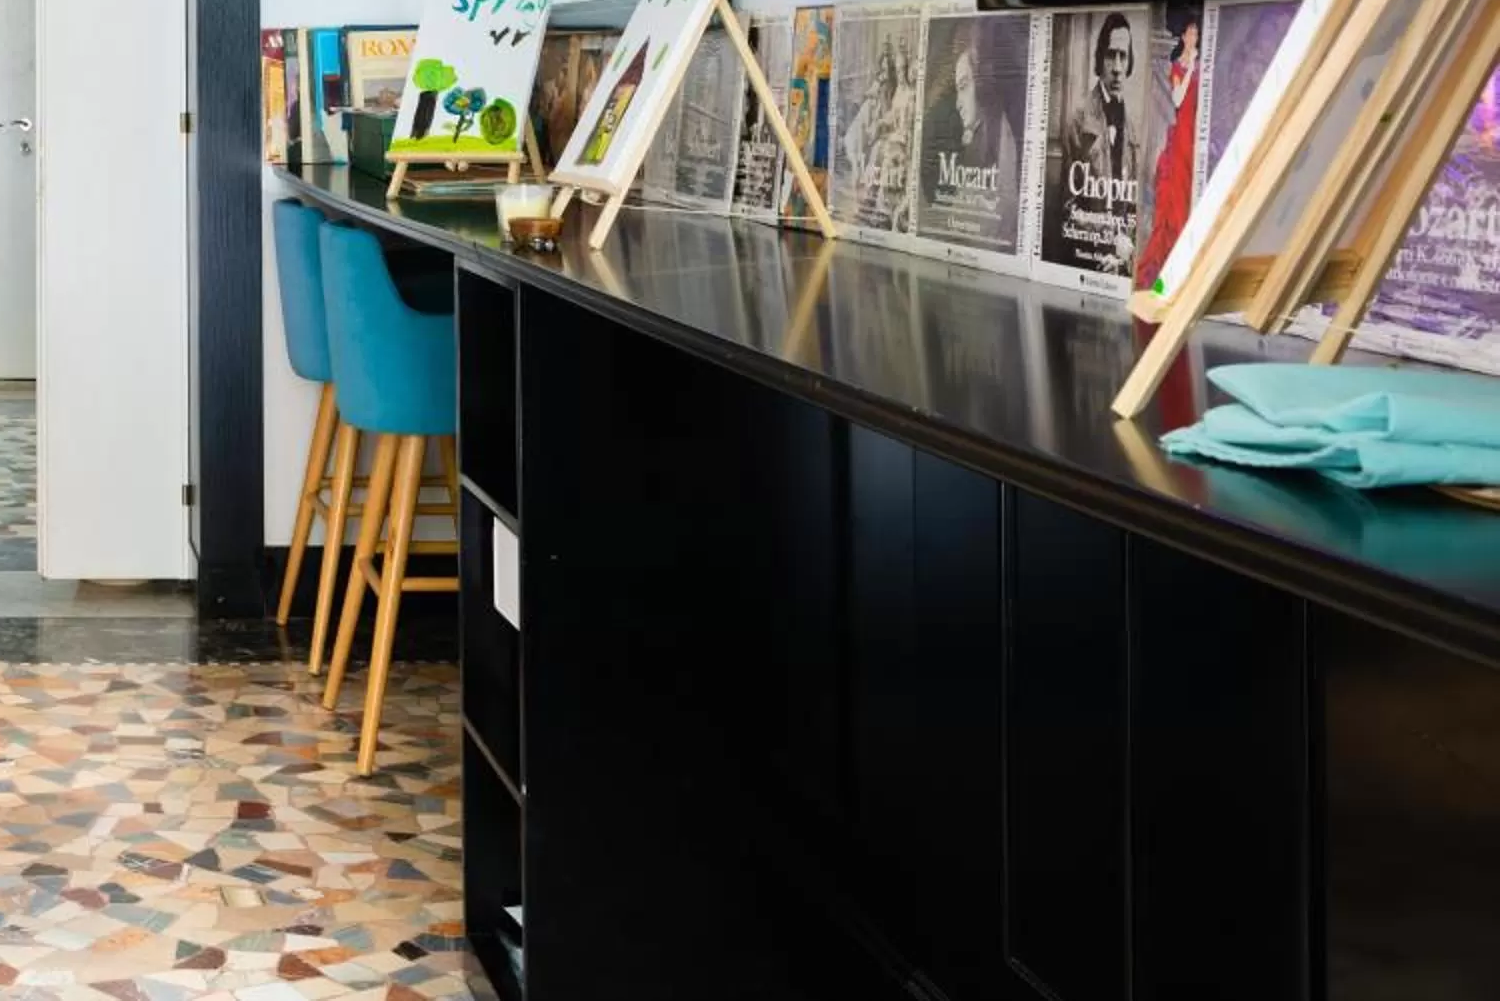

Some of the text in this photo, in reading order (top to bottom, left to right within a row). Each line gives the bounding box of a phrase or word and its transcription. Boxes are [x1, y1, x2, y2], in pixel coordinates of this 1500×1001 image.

[938, 151, 998, 192] Mozart
[1068, 160, 1138, 210] Chopin
[1406, 202, 1500, 243] ozart
